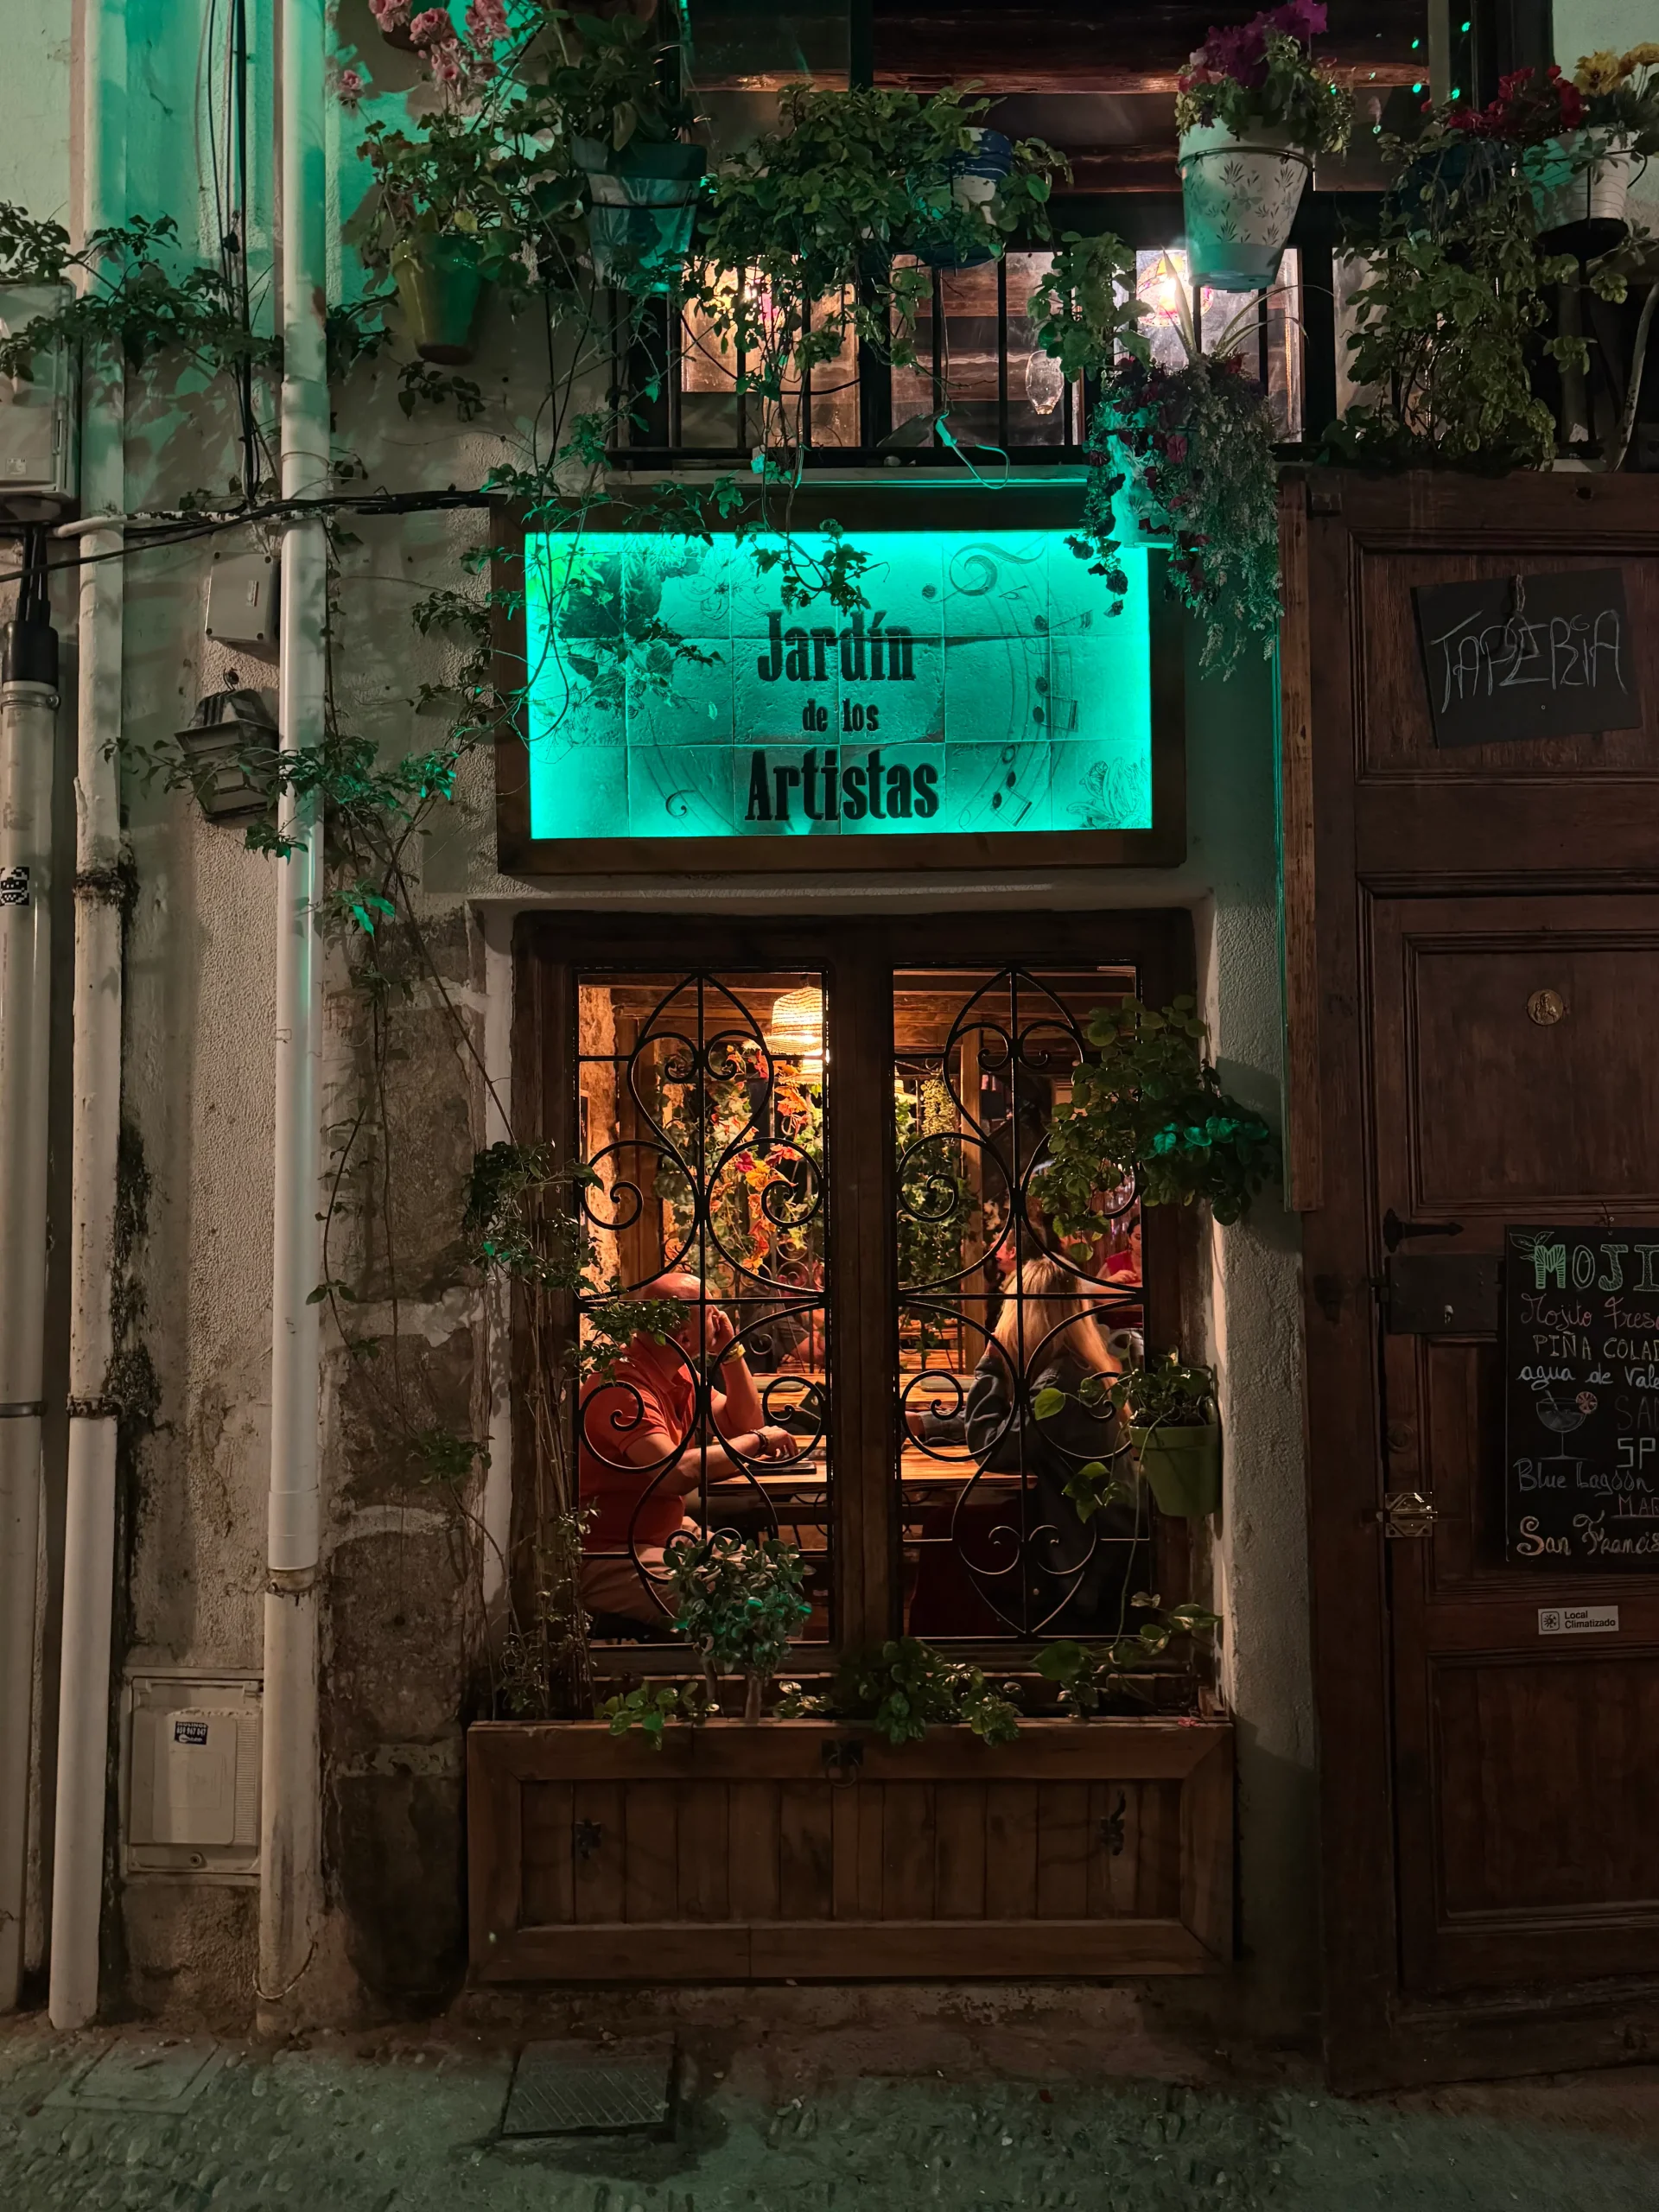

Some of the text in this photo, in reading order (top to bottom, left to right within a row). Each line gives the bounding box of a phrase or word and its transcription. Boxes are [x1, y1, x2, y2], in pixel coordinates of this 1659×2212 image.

[758, 608, 917, 683] Jardín
[801, 696, 879, 733] de los
[744, 748, 941, 822] Artistas
[1520, 1293, 1593, 1332] Mojito
[1532, 1331, 1592, 1361] PIÑA
[1516, 1364, 1576, 1391] agua
[1584, 1362, 1614, 1384] de
[1512, 1458, 1655, 1497] Blue Lagoon
[1516, 1515, 1572, 1556] San
[1564, 1610, 1588, 1619] Local
[1564, 1618, 1616, 1630] Climatizado
